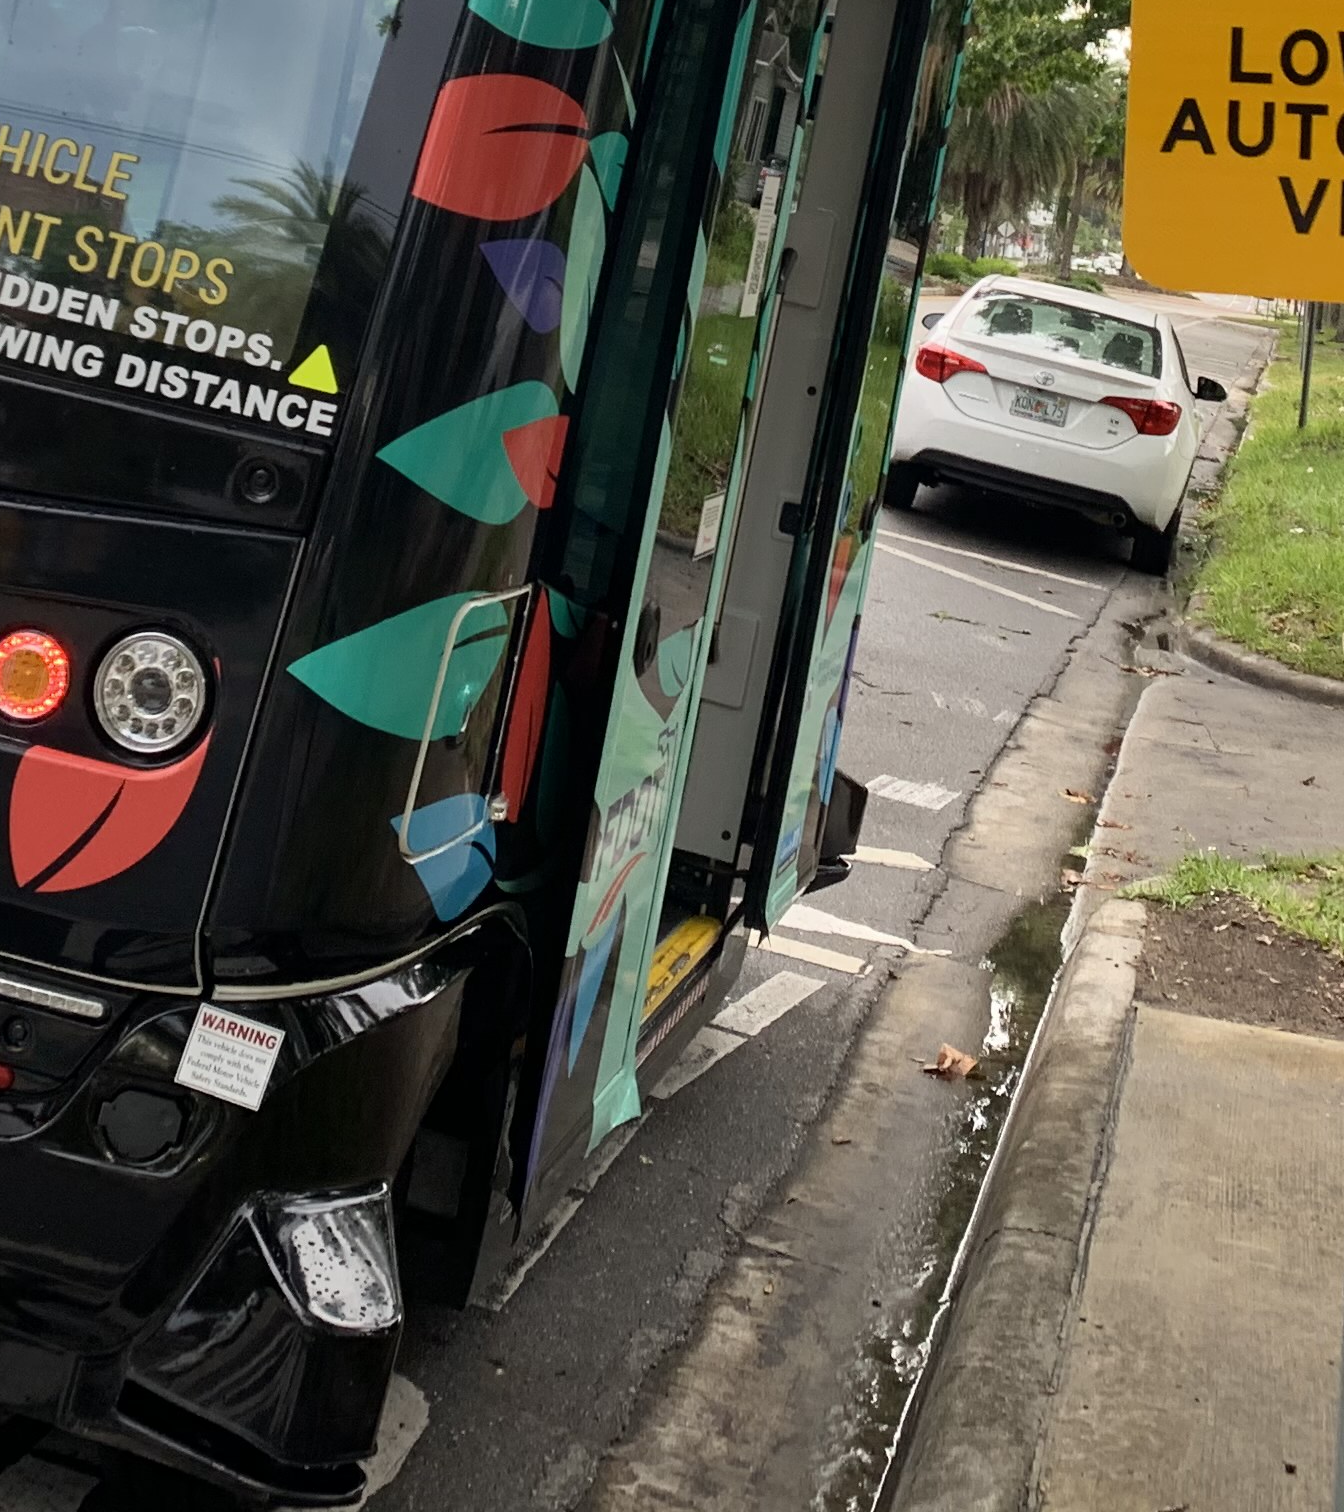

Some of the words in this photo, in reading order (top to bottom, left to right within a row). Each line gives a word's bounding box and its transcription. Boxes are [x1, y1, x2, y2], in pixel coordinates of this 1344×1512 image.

[68, 225, 234, 306] STOPS
[129, 306, 282, 372] STOPS.
[115, 353, 338, 436] DISTANCE
[197, 1034, 212, 1047] This
[213, 1040, 237, 1055] vehicle
[238, 1048, 253, 1061] does
[255, 1056, 267, 1065] not
[201, 1012, 278, 1050] WARNING
[186, 1056, 212, 1072] Federal
[236, 1072, 260, 1089] Vehicle
[227, 1058, 242, 1070] with
[243, 1063, 254, 1073] the
